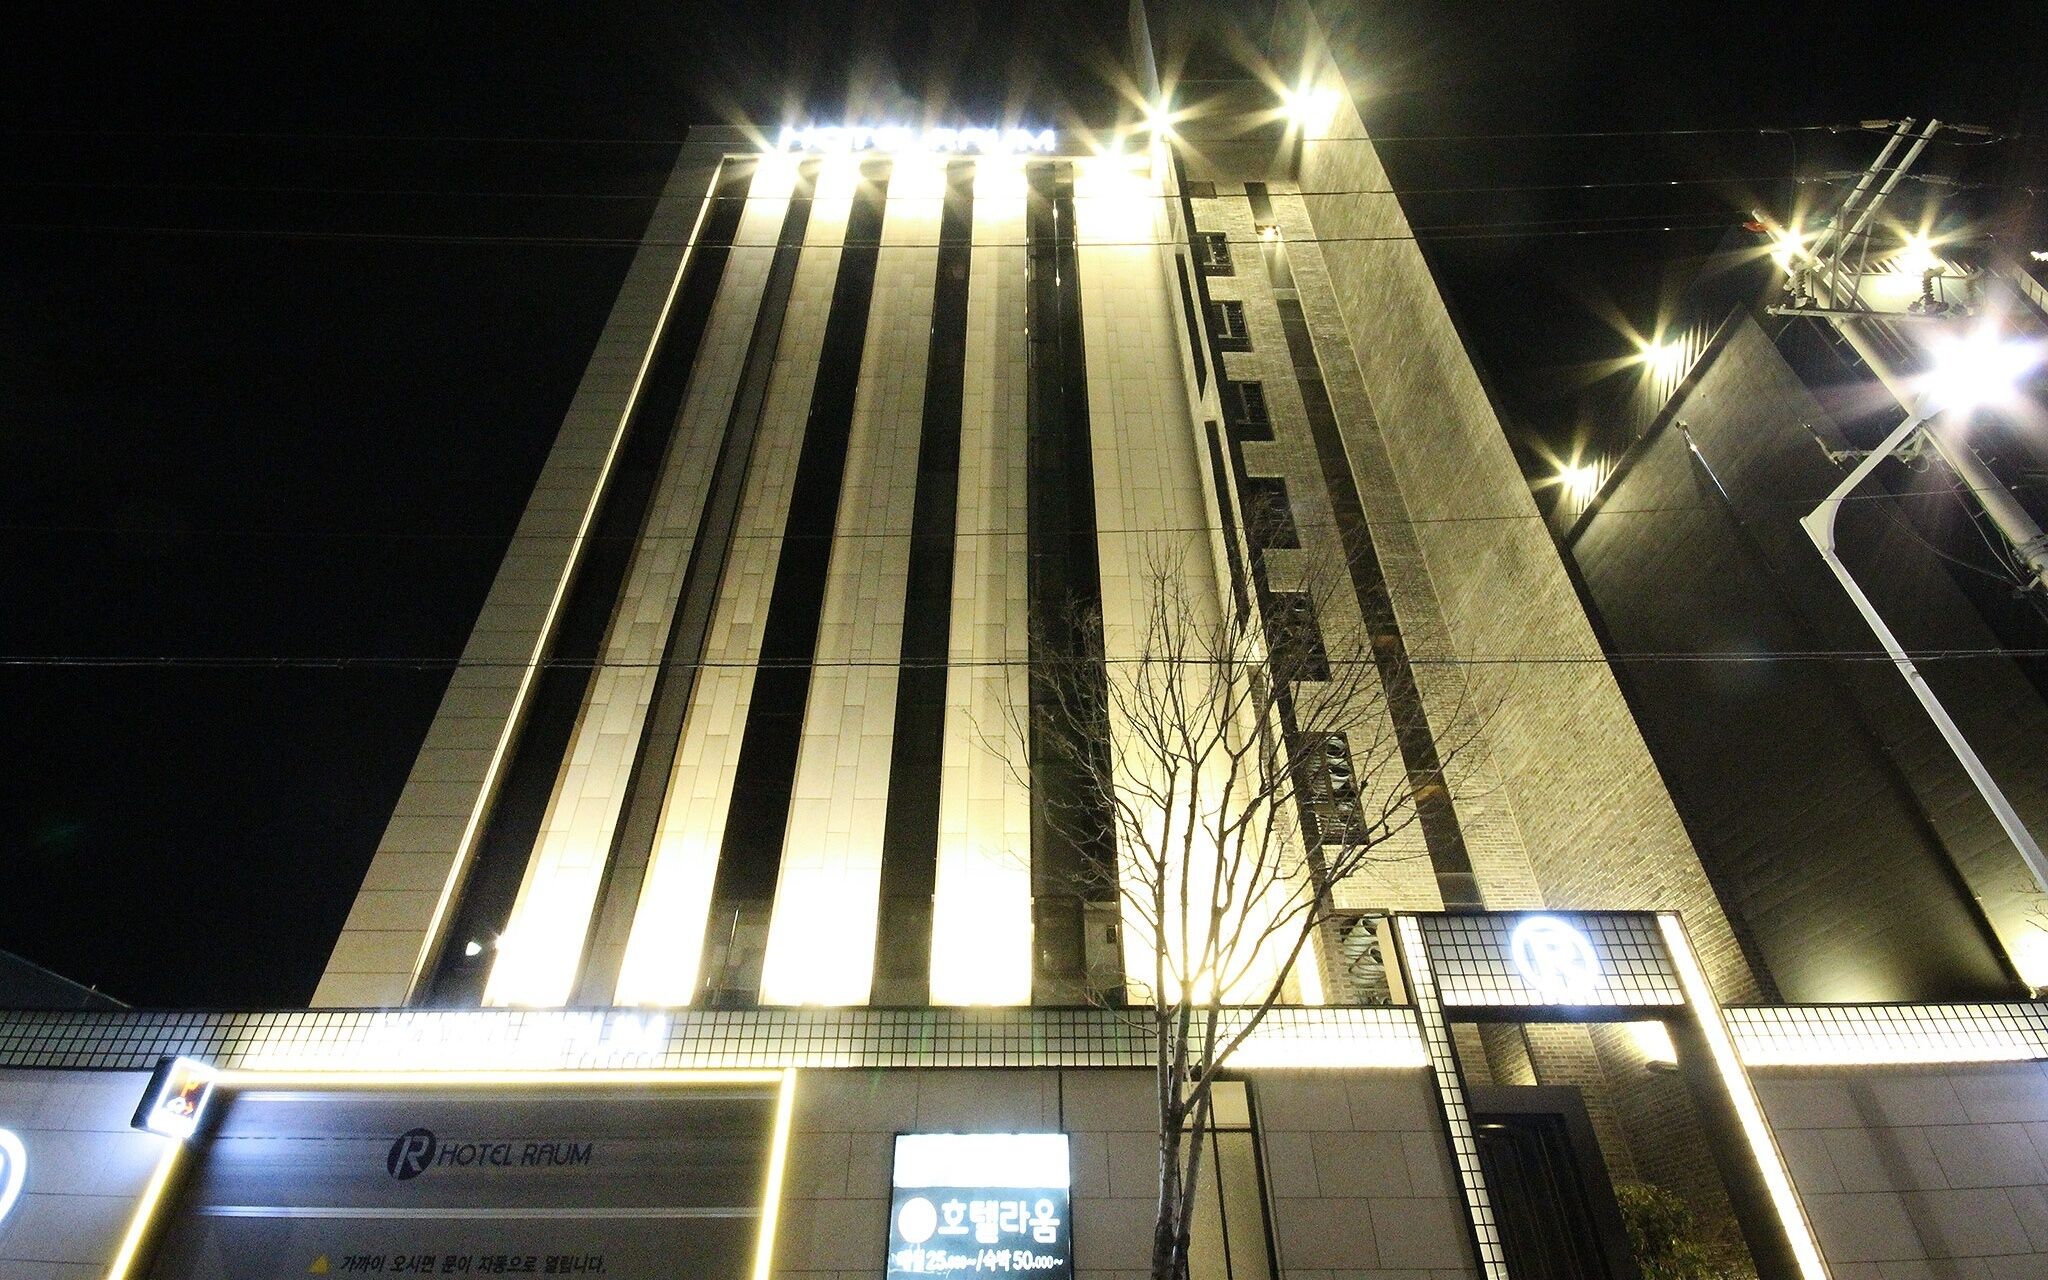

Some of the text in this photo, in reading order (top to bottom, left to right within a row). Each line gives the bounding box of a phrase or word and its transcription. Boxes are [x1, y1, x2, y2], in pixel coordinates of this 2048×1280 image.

[437, 1143, 512, 1167] HOTEL
[521, 1143, 592, 1166] RAUM
[937, 1198, 1061, 1244] 호텔라움
[341, 1255, 386, 1273] 가까이
[390, 1255, 436, 1273] 오시면
[441, 1255, 473, 1273] 문이
[478, 1255, 538, 1274] 자동으로
